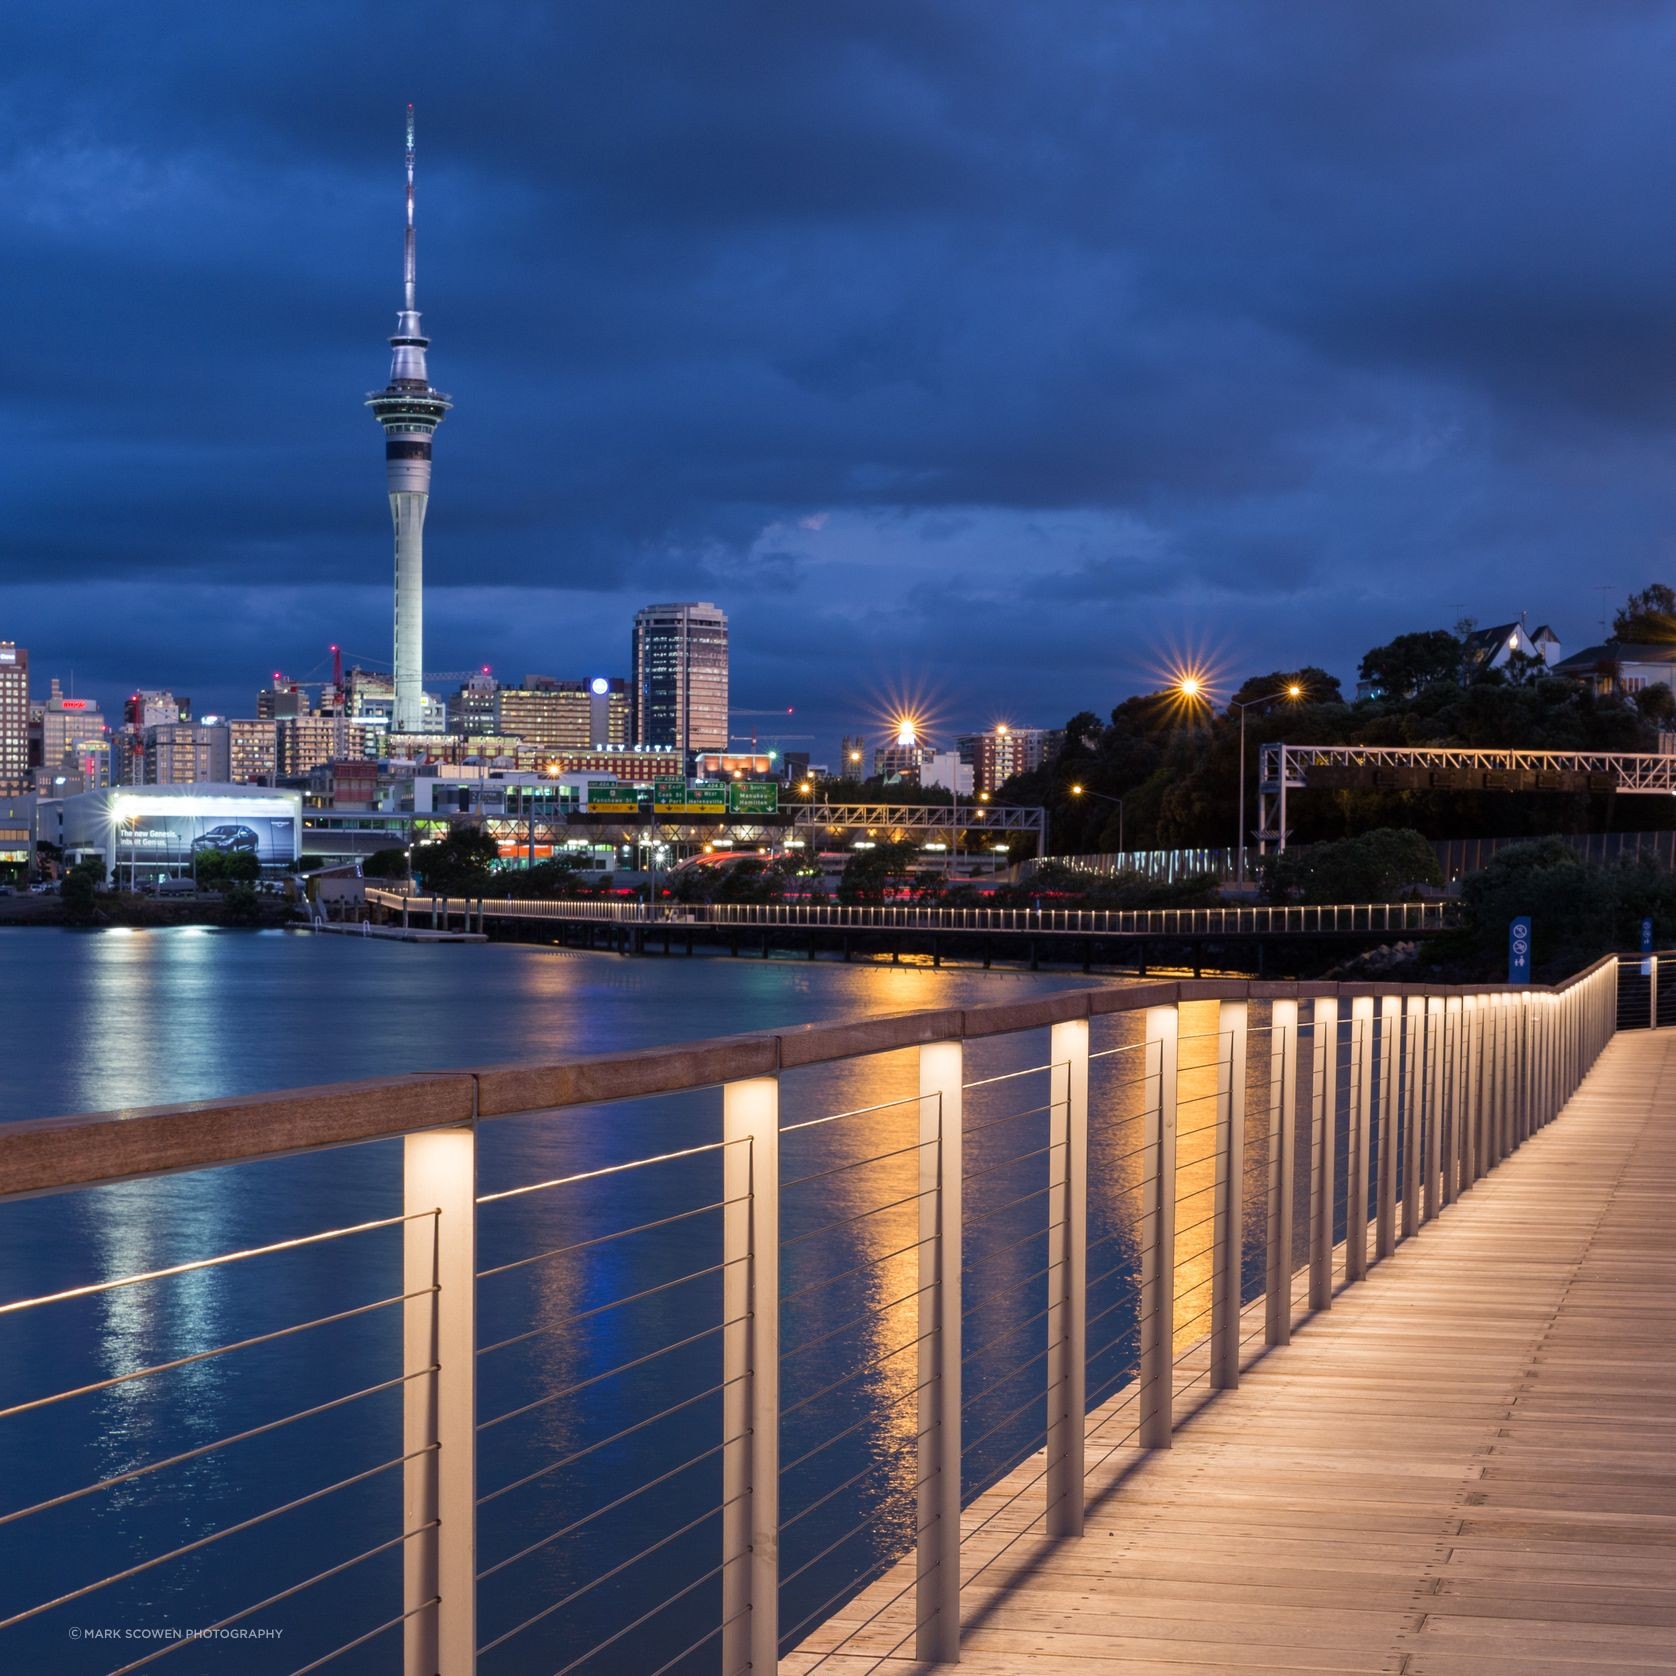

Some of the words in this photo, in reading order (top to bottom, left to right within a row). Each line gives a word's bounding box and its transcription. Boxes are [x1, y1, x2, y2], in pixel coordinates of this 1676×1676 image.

[597, 744, 625, 752] SKY
[634, 744, 672, 752] CITY
[142, 839, 167, 847] Genus.
